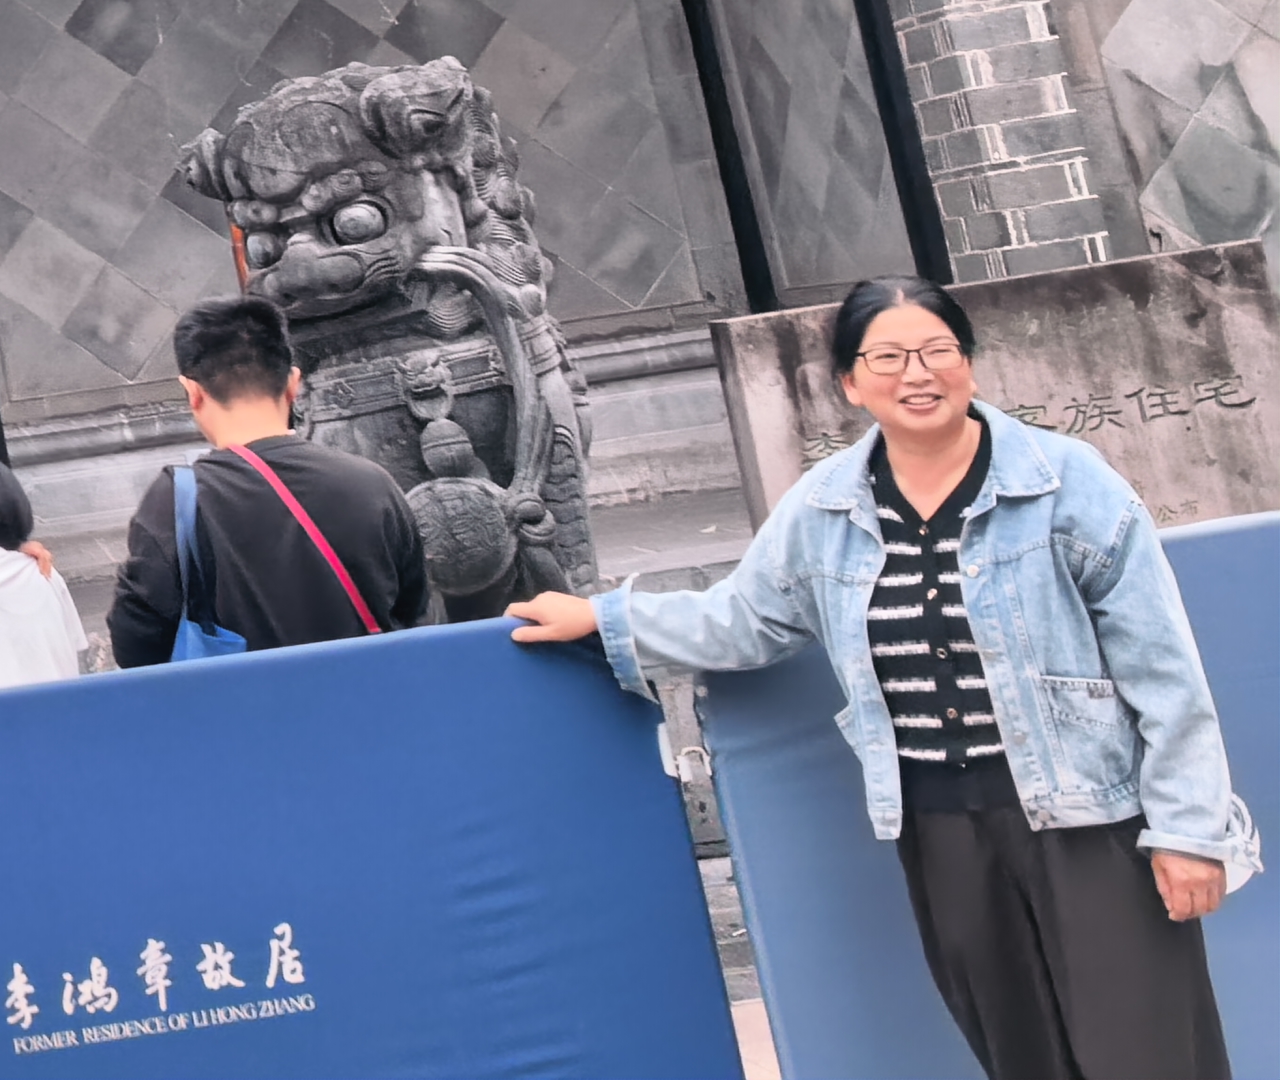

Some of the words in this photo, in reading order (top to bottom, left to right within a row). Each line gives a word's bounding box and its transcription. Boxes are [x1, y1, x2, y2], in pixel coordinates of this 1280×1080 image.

[13, 1030, 79, 1054] FORMER
[83, 1017, 166, 1045] RESIDENCE
[168, 1013, 191, 1031] OF
[192, 1009, 211, 1029] LI
[211, 1001, 258, 1025] HONG
[258, 993, 316, 1018] ZHANG
